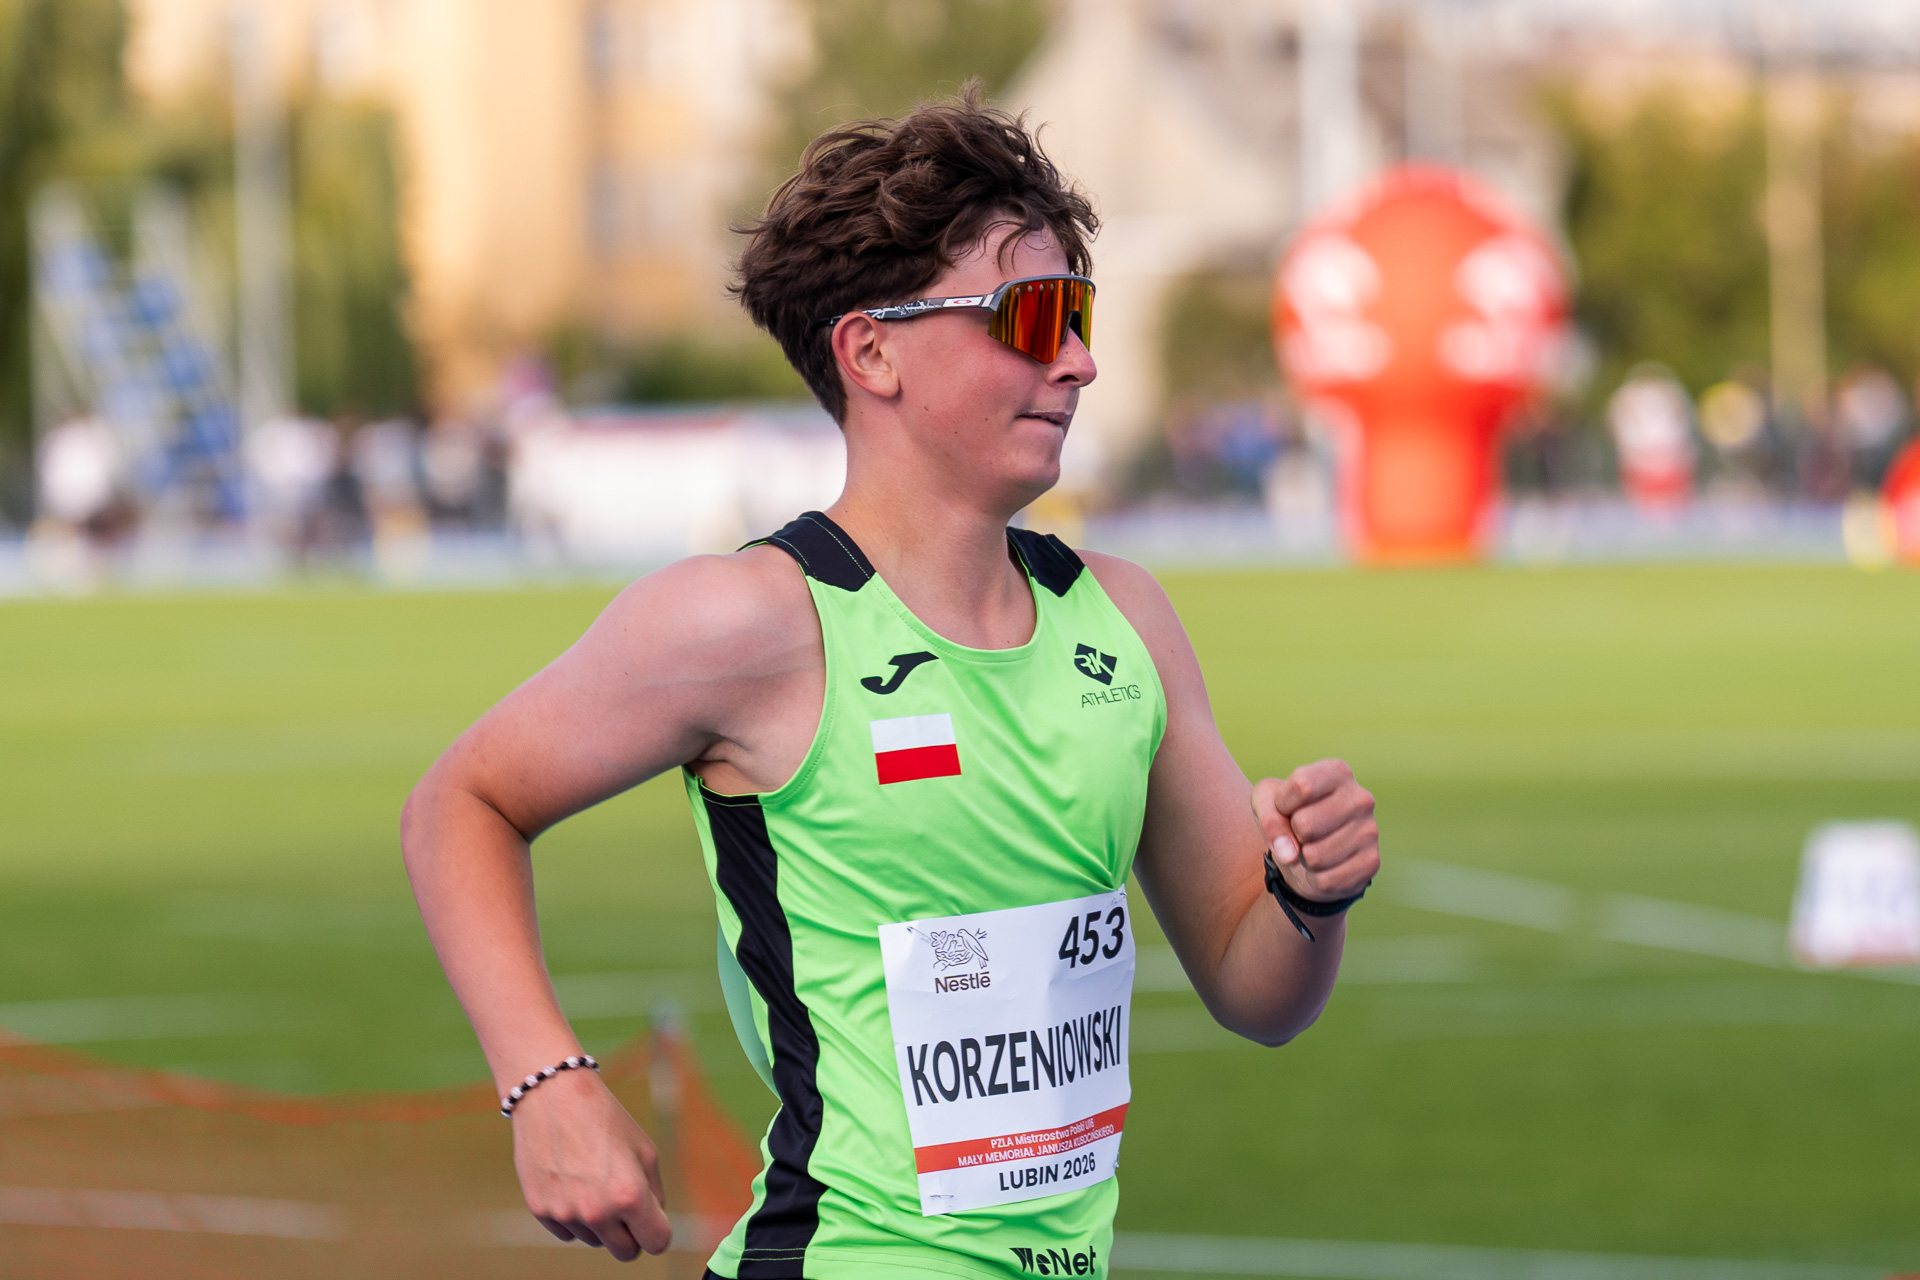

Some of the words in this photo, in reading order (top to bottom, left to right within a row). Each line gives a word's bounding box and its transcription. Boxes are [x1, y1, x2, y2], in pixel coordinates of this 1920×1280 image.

[1081, 684, 1142, 708] ATHLETICS
[1058, 906, 1125, 969] 453
[934, 970, 991, 994] Nestlé
[906, 1004, 1122, 1106] KORZENIOWSKI
[957, 1153, 983, 1167] MAŁY
[985, 1146, 1036, 1163] MEMORIAŁ
[1036, 1139, 1073, 1156] JANUSZA
[1073, 1124, 1115, 1147] KUSOCIŃSKIEGO
[990, 1137, 1014, 1149] PZLA
[1014, 1129, 1070, 1146] Mistrzostwa
[1069, 1120, 1086, 1135] Polski
[998, 1161, 1059, 1192] LUBIN
[1063, 1151, 1096, 1180] 2026
[1009, 1245, 1097, 1276] WeNet
